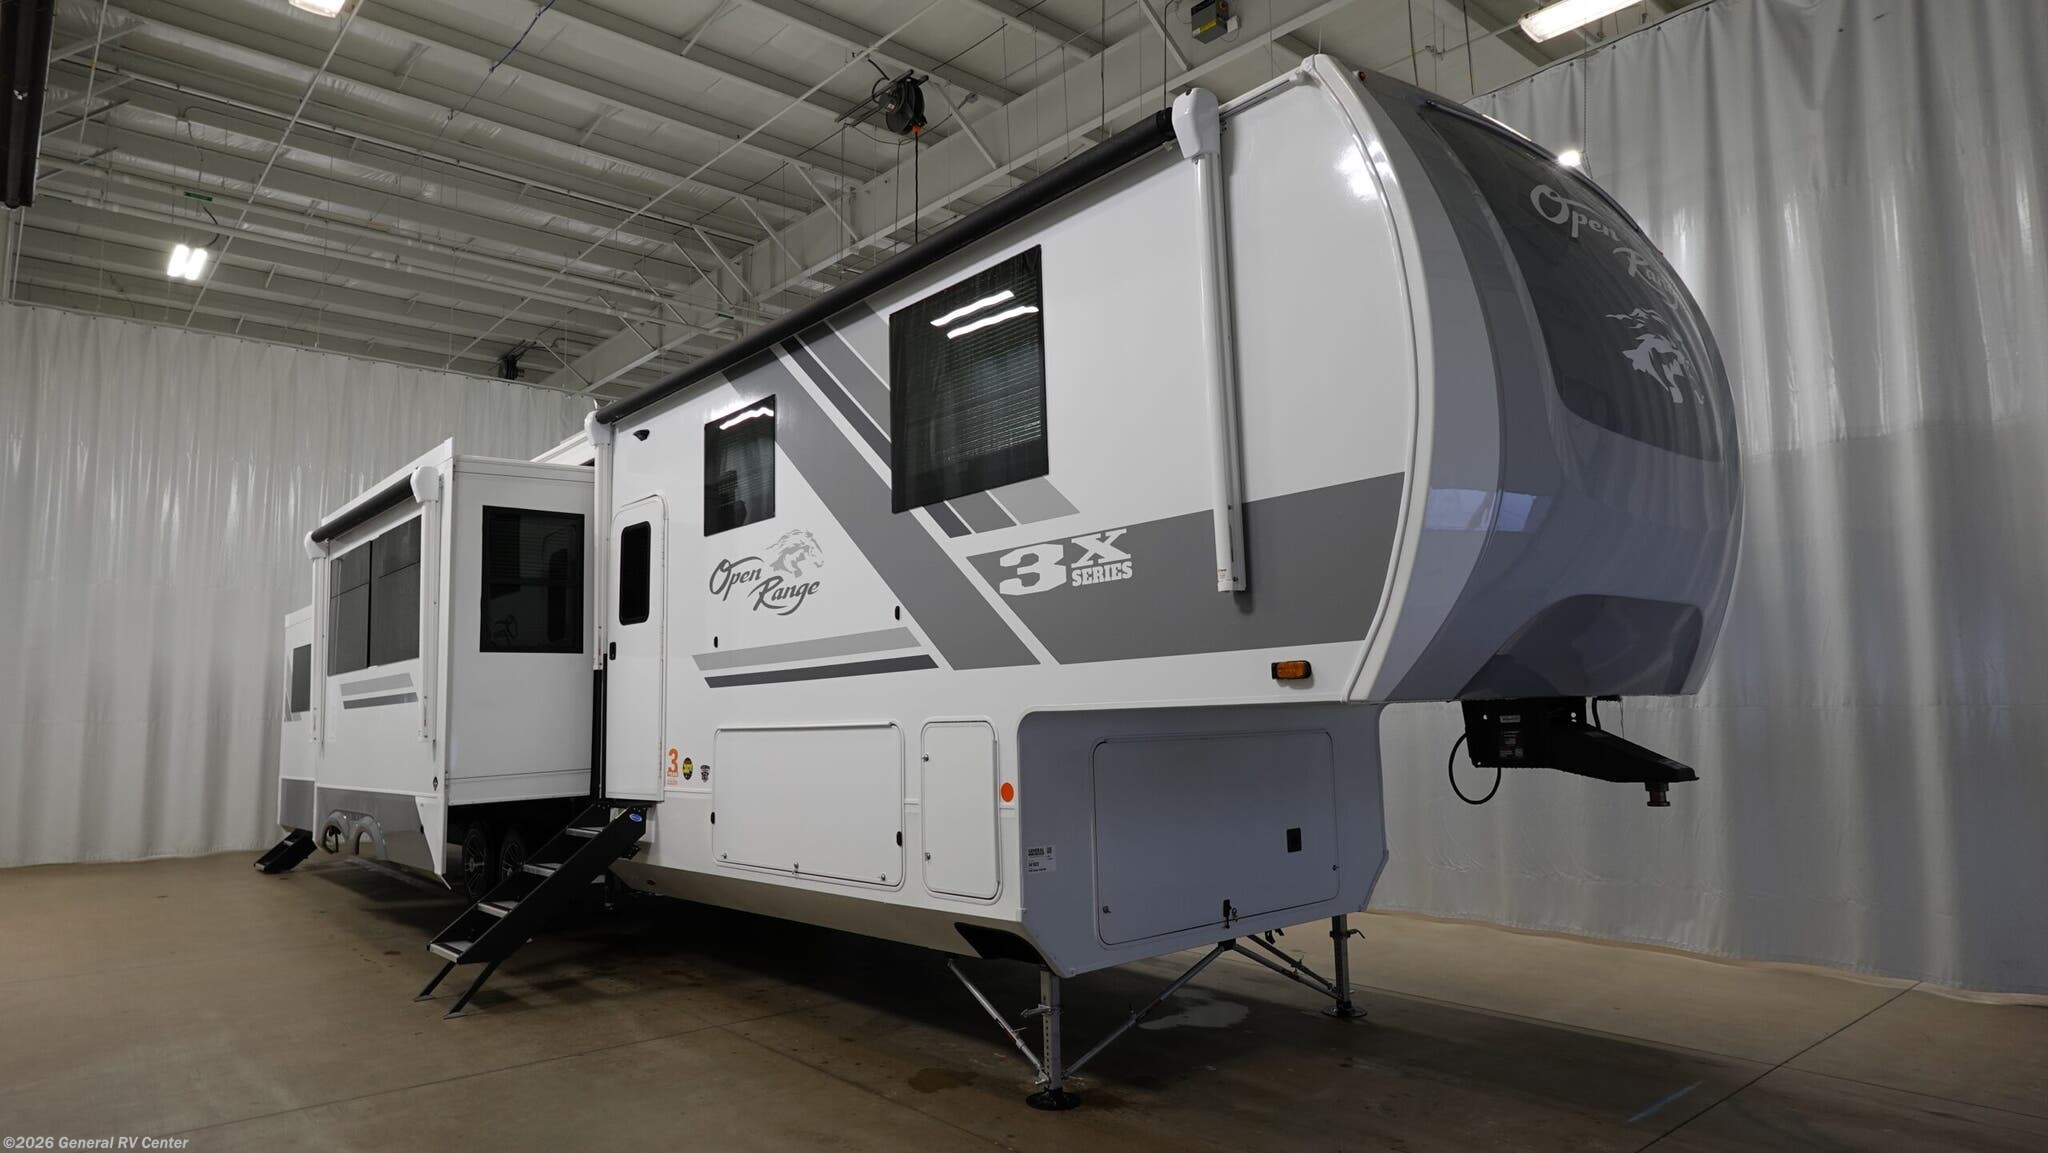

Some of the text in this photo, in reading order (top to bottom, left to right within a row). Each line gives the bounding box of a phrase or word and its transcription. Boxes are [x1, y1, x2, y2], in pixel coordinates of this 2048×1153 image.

[1530, 184, 1621, 242] Open
[1612, 247, 1679, 312] Rang
[709, 556, 764, 601] Open
[1071, 560, 1133, 587] SERIES
[747, 575, 820, 616] Range
[667, 748, 678, 773] 3
